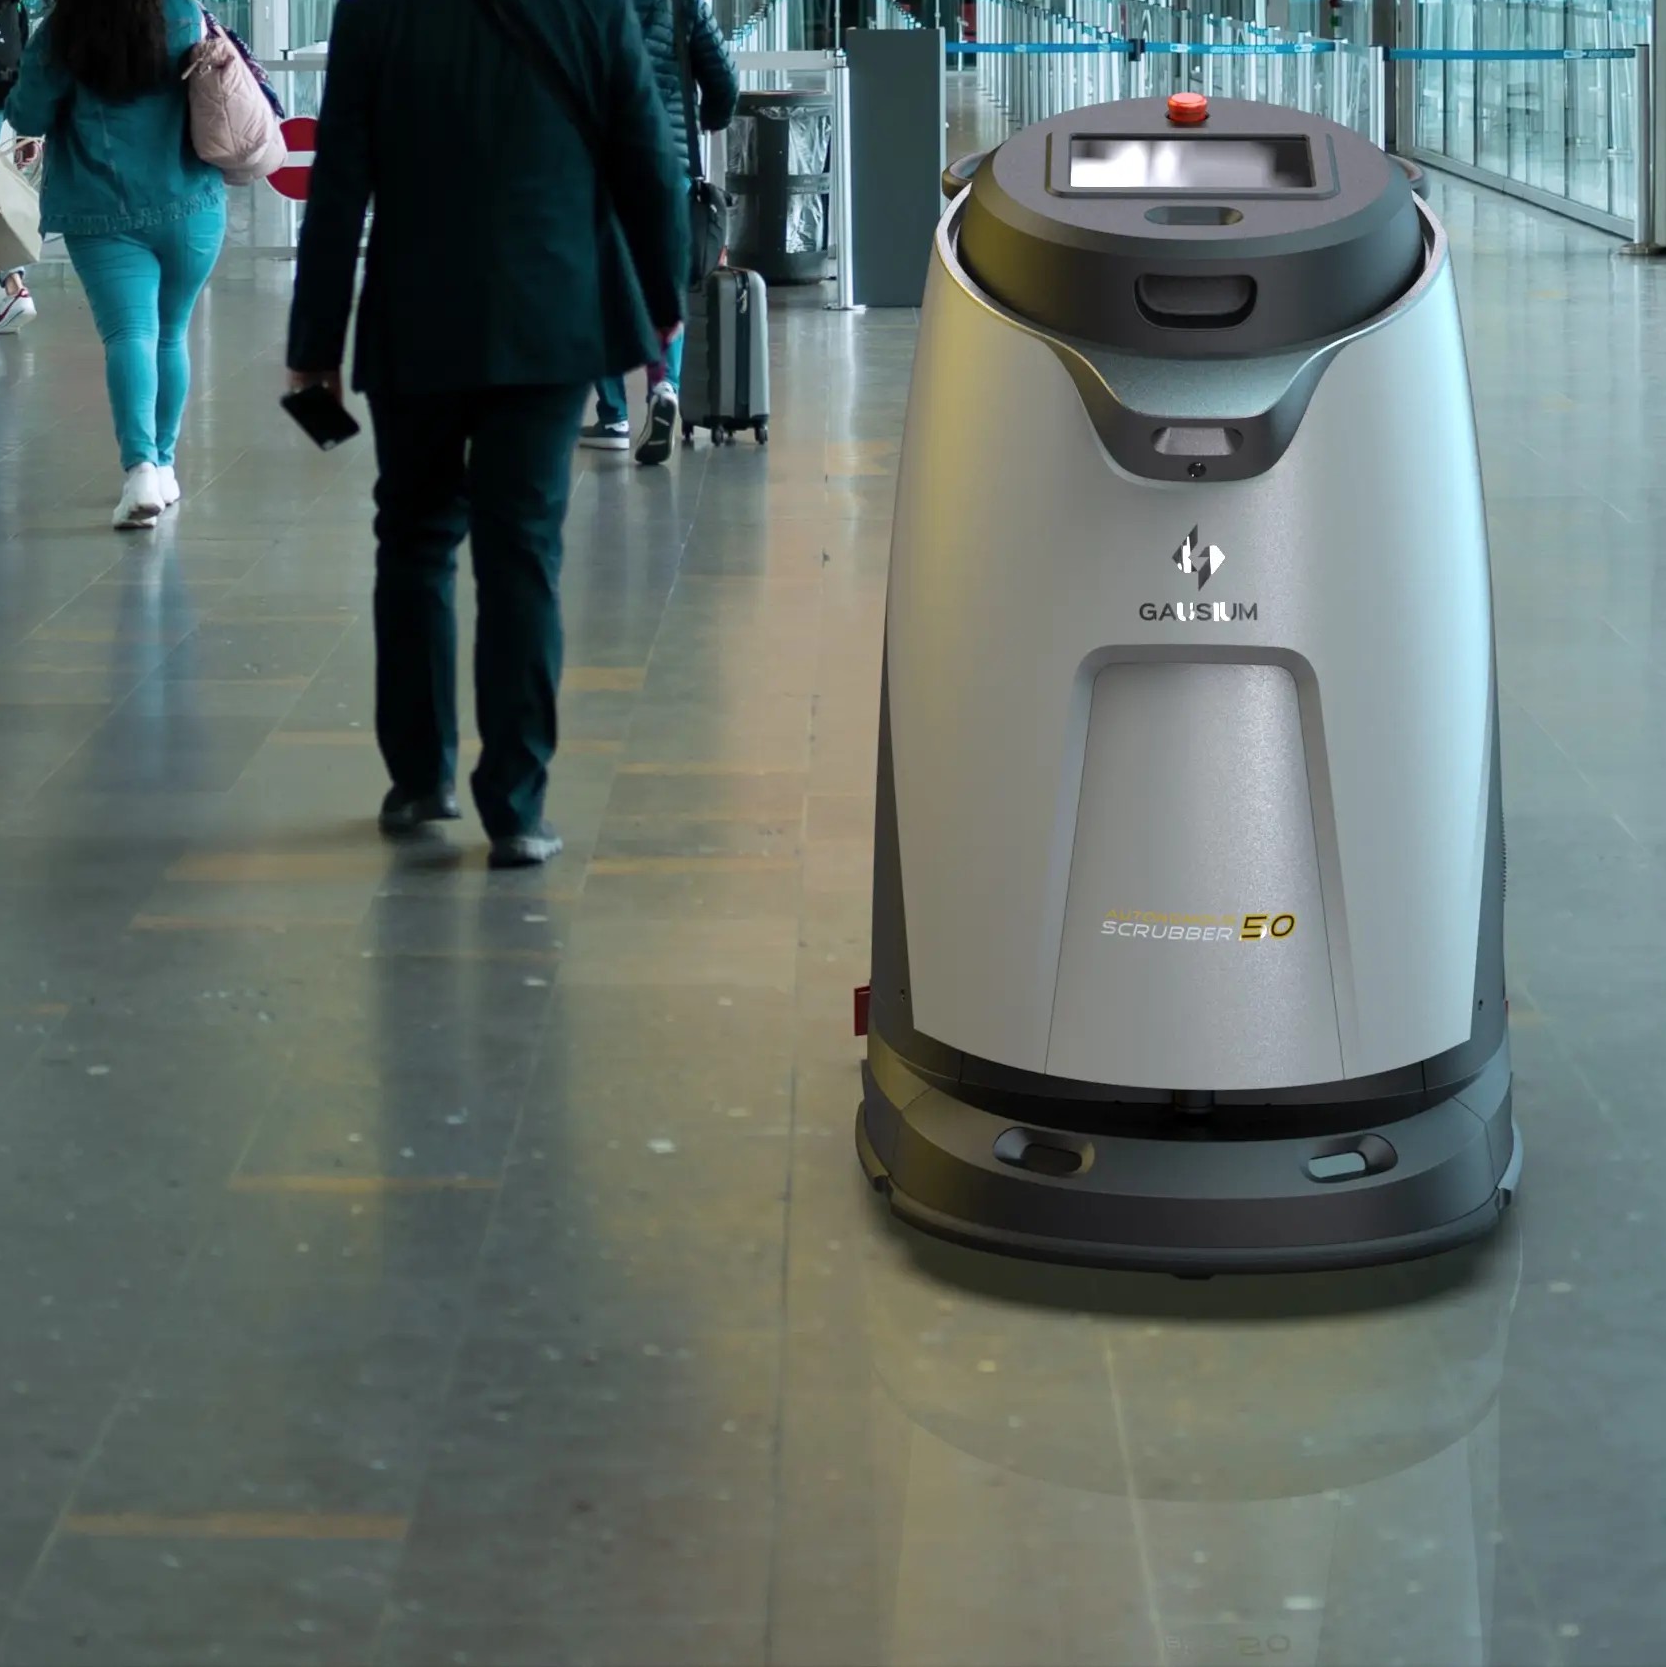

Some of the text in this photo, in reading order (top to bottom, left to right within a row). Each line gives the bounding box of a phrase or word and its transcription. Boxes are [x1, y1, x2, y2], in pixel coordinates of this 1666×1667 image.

[1139, 601, 1258, 622] GAUSIUM
[1101, 911, 1298, 942] SCRUBBER 50
